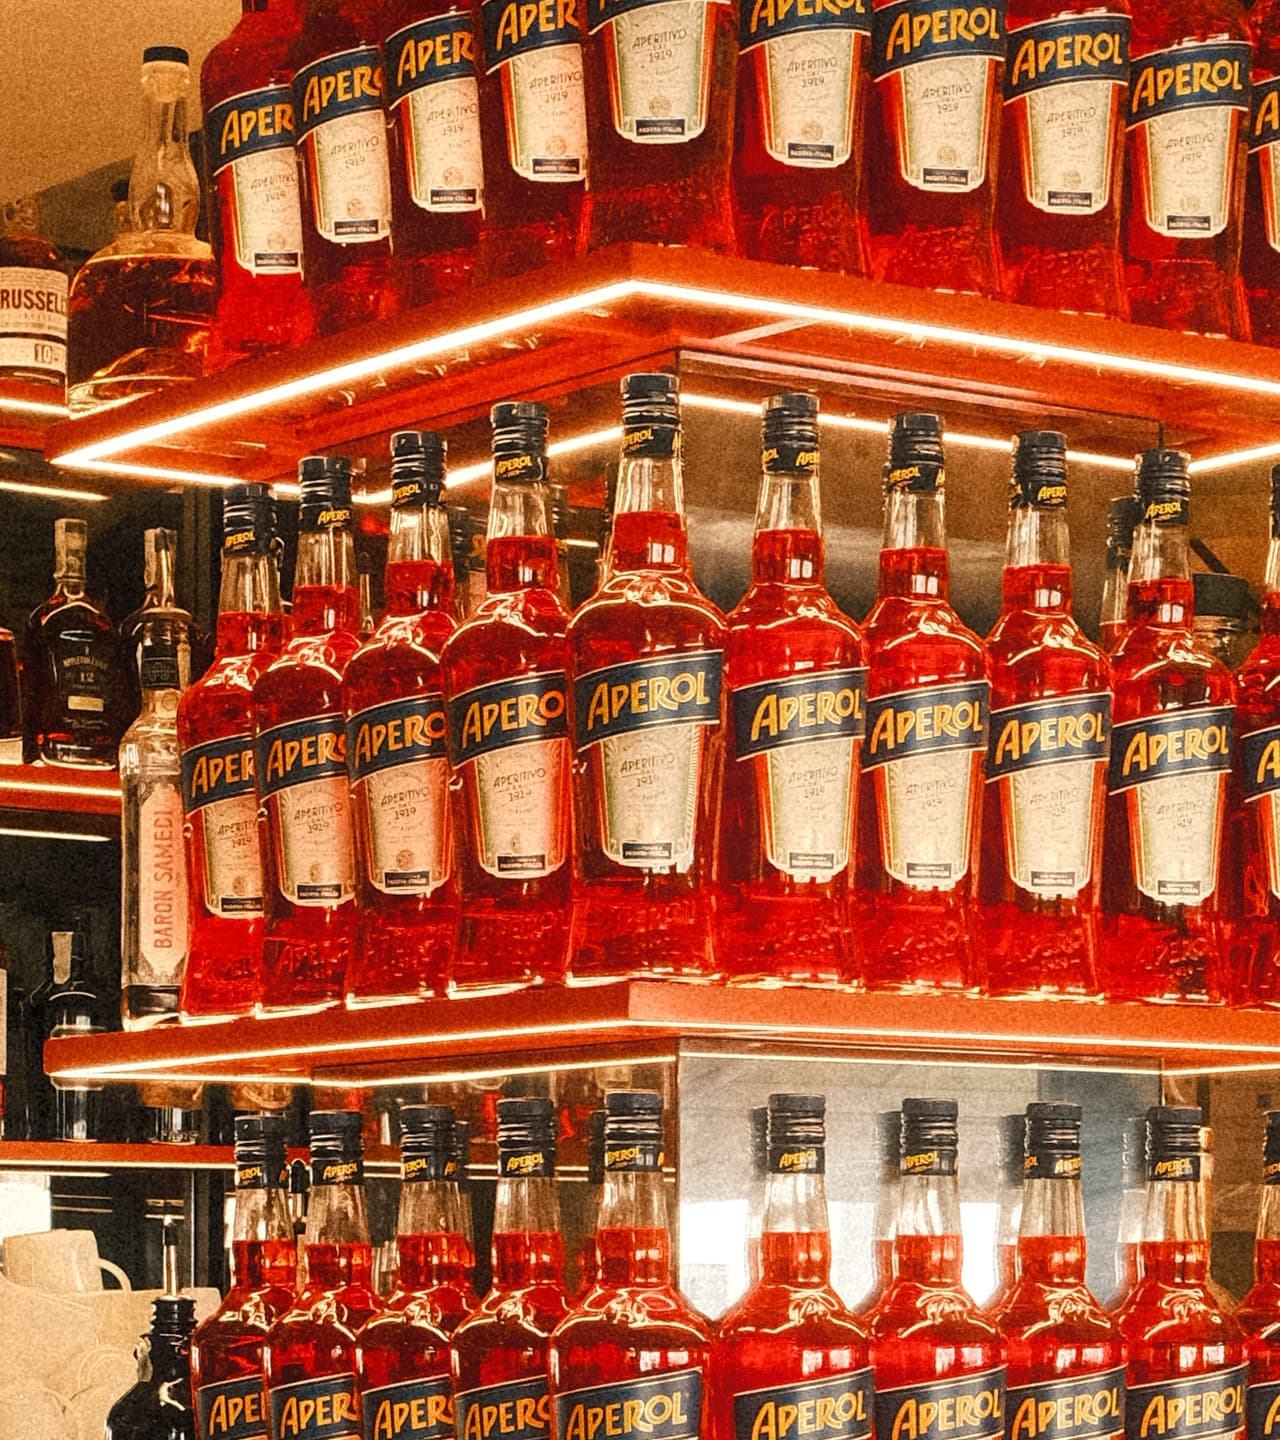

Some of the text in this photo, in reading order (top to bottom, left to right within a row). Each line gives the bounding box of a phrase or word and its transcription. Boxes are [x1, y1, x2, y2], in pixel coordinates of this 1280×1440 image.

[398, 30, 476, 86] APER
[649, 49, 673, 63] 1919
[886, 7, 1000, 61] APEROL
[1012, 33, 1122, 86] APEROL
[303, 65, 383, 122] APER
[1131, 60, 1242, 114] APEROL
[220, 103, 295, 154] APER
[0, 289, 66, 314] RUSSELL
[496, 455, 533, 475] APEROL
[317, 509, 350, 525] APERO
[1145, 501, 1182, 519] APEROL
[461, 690, 565, 748] APERO
[588, 672, 710, 731] APEROL
[750, 687, 861, 741] APEROL
[354, 712, 447, 768] APERO
[870, 701, 983, 755] APEROL
[995, 712, 1106, 766] APEROL
[1123, 725, 1229, 776] APEROL
[191, 752, 256, 799] APER
[266, 733, 347, 782] APER
[394, 806, 417, 819] 1919
[153, 811, 173, 949] BARON SAMEDI
[323, 1161, 358, 1179] APEROL
[507, 1152, 544, 1171] APEROL
[209, 1392, 267, 1434] APE
[280, 1389, 359, 1439] APER
[1011, 1386, 1119, 1440] APEROL
[1140, 1386, 1243, 1438] APEROL
